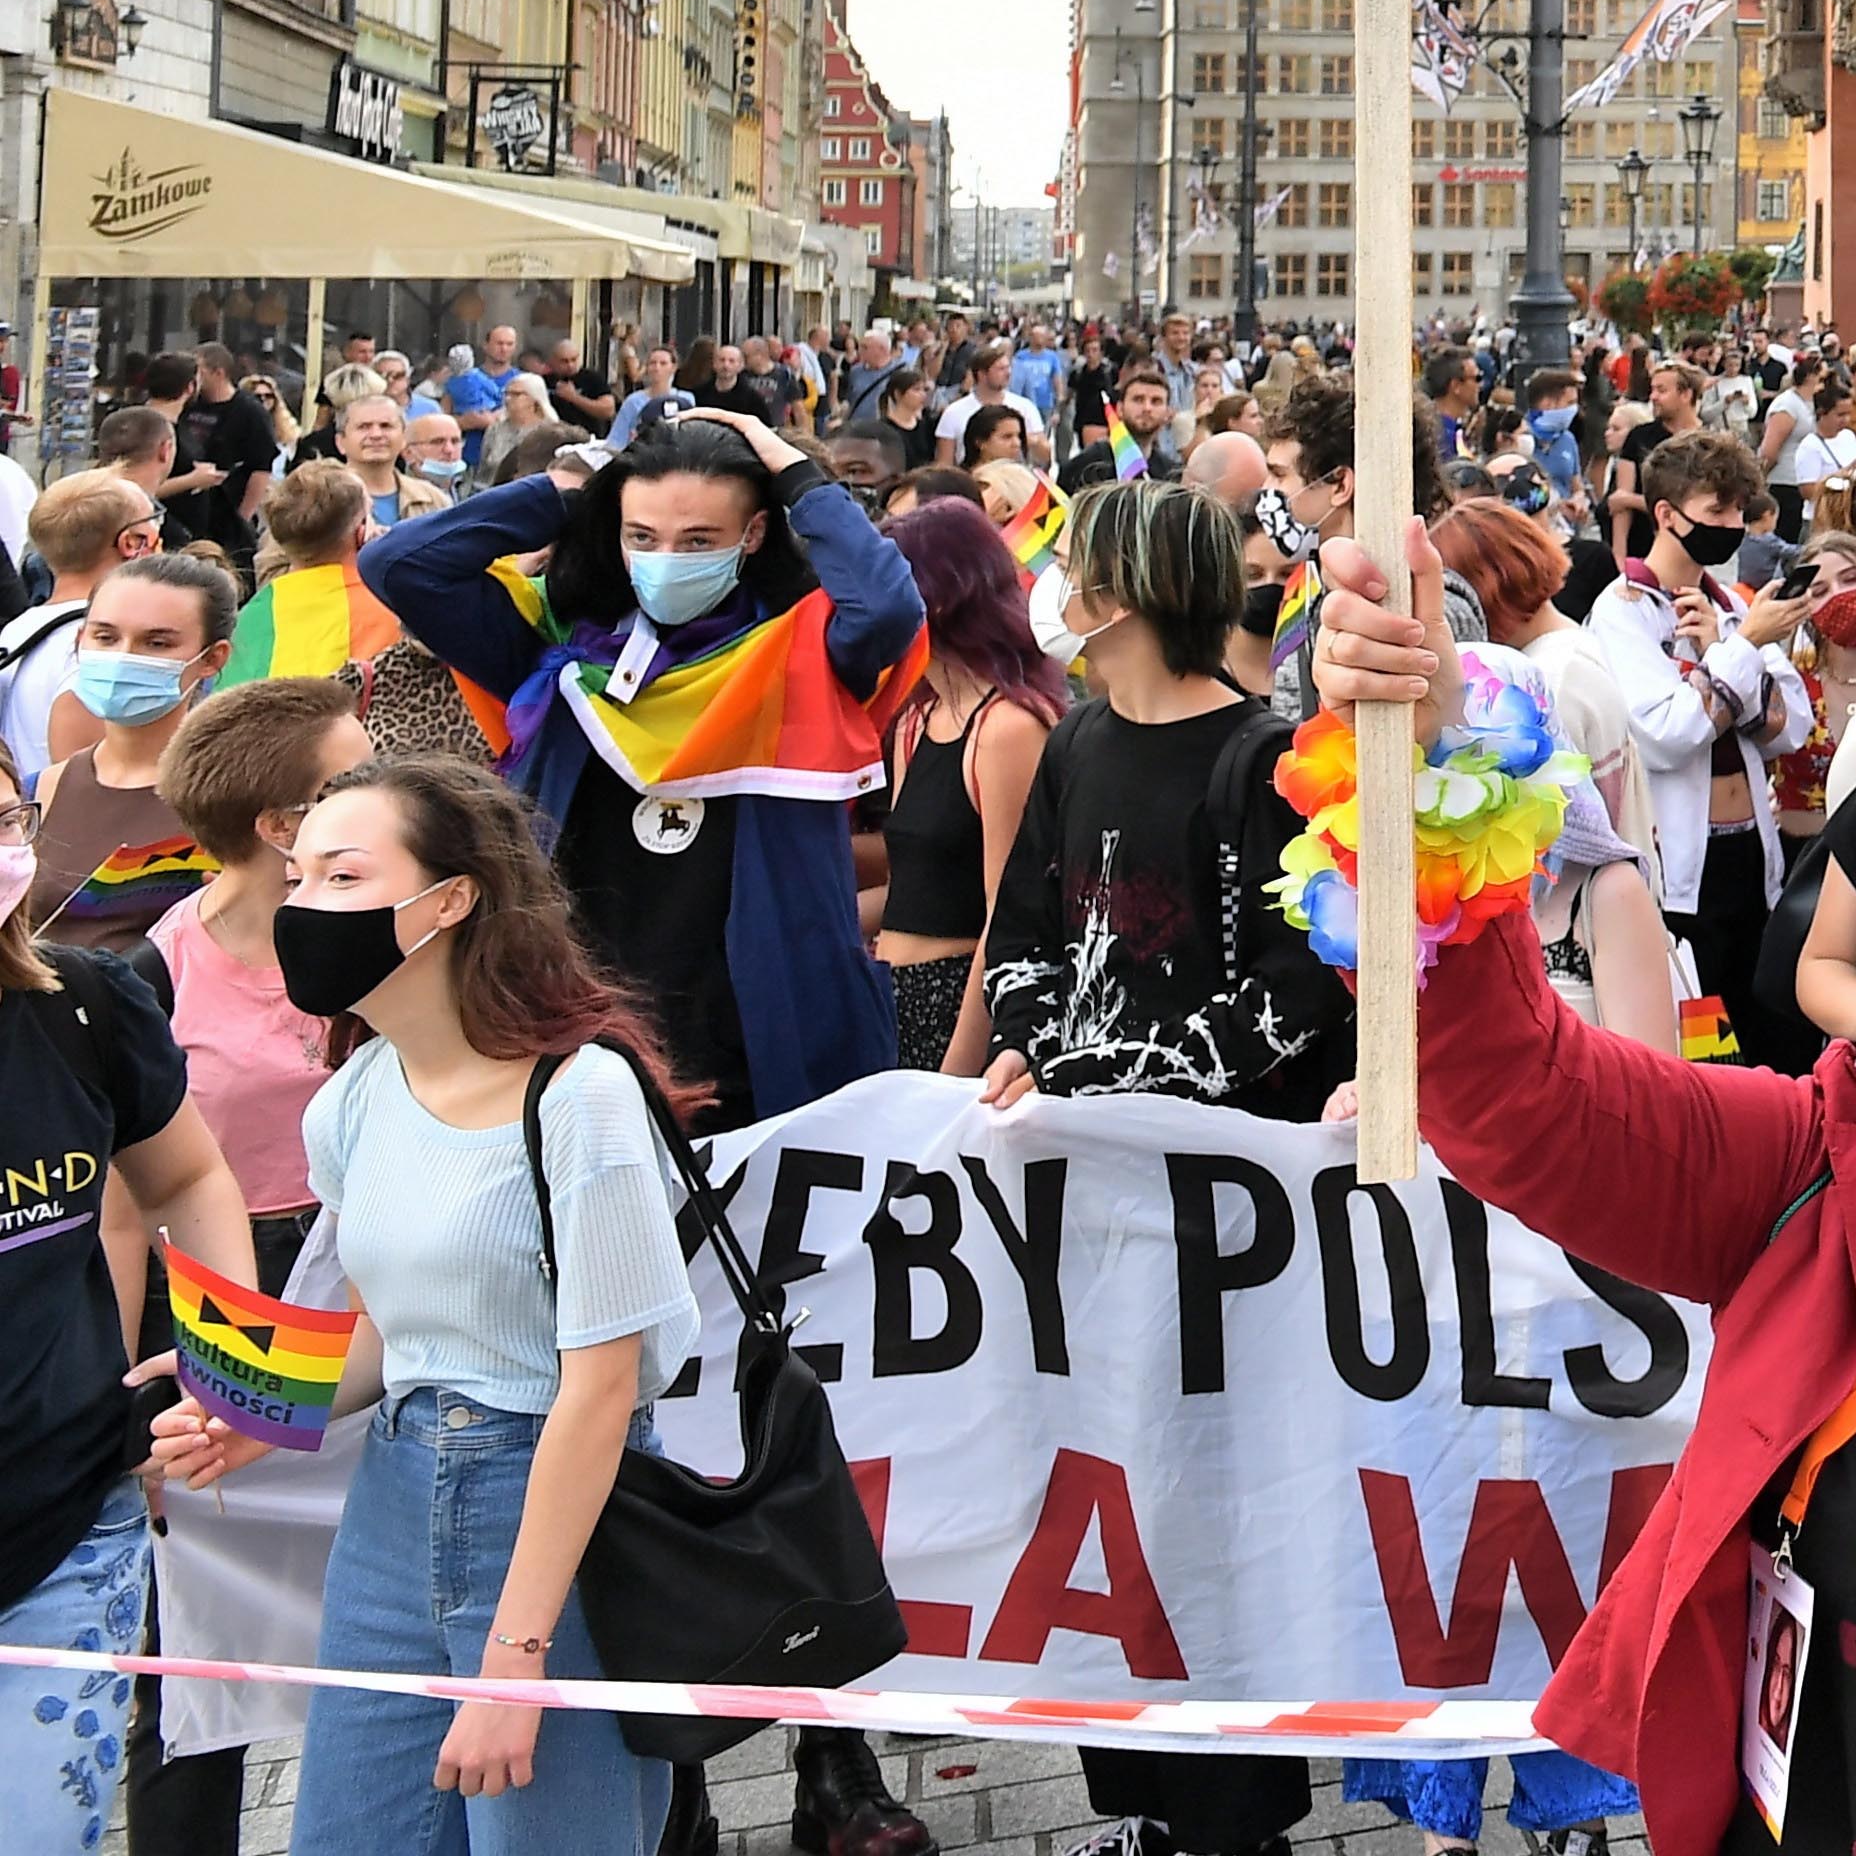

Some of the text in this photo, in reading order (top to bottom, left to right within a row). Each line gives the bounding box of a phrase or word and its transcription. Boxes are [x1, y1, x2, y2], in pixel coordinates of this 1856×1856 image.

[89, 176, 212, 227] Zamkowe
[177, 1343, 296, 1424] ówności
[180, 1321, 283, 1393] kultura
